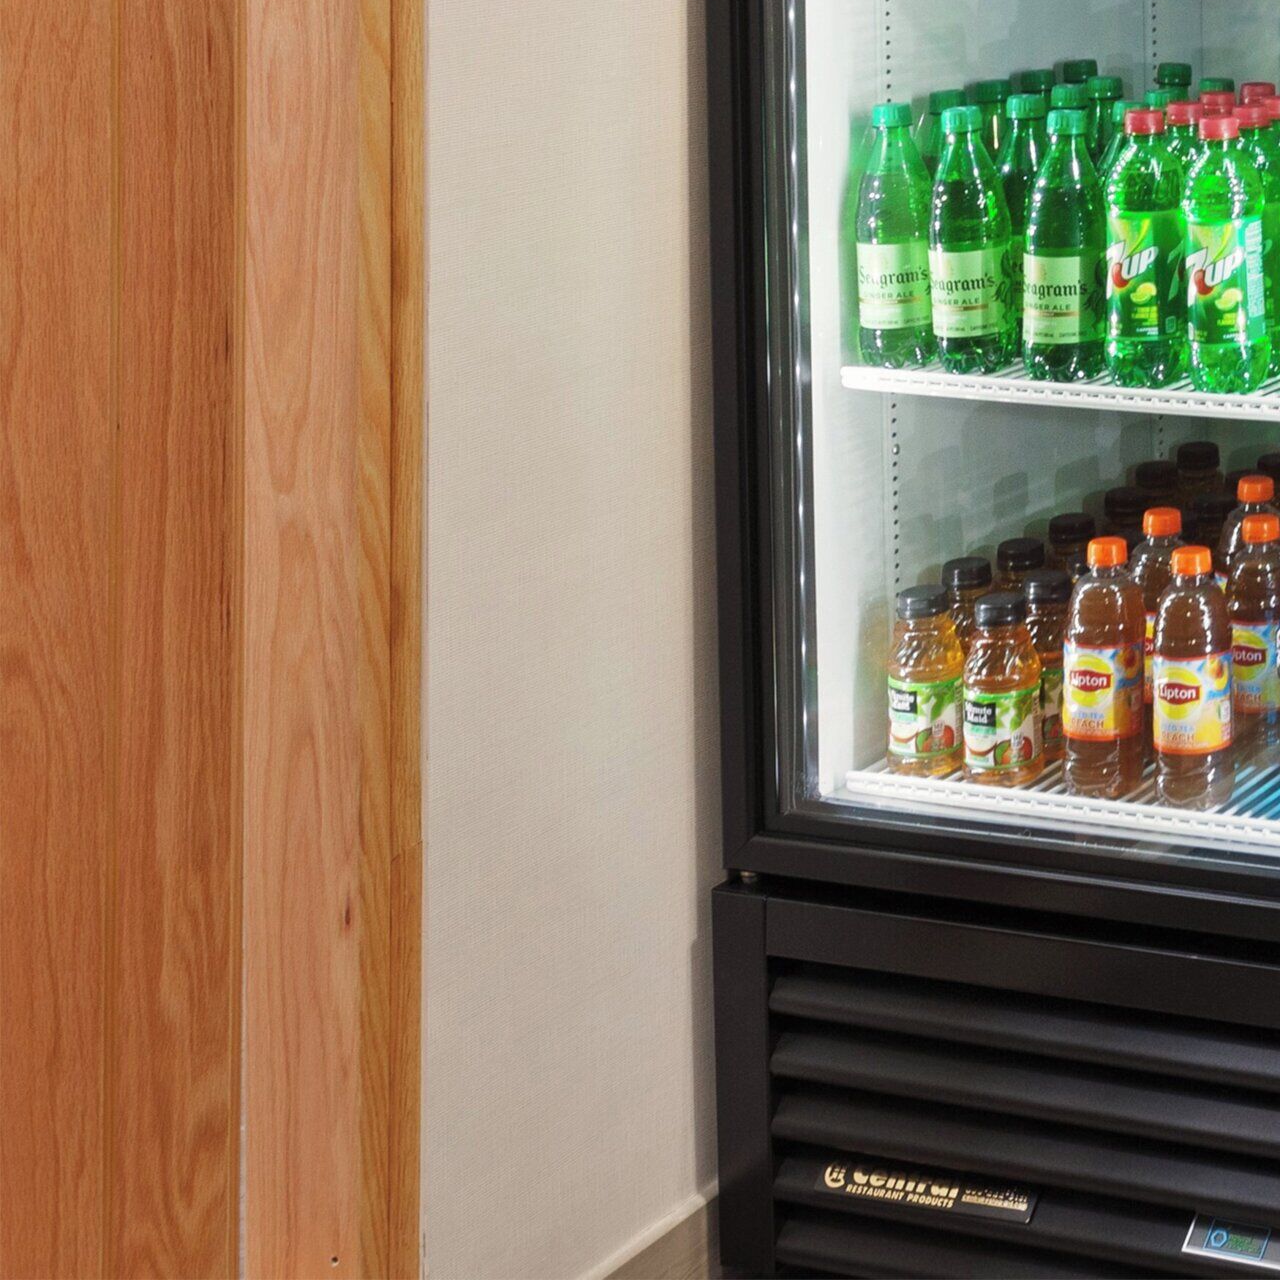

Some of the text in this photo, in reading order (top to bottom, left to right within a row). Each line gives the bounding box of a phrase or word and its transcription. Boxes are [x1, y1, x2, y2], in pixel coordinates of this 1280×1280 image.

[1231, 645, 1263, 665] ipton
[1160, 685, 1198, 703] Lipton
[846, 1184, 906, 1201] RESTAURANT
[906, 1192, 955, 1209] PRODUCTS
